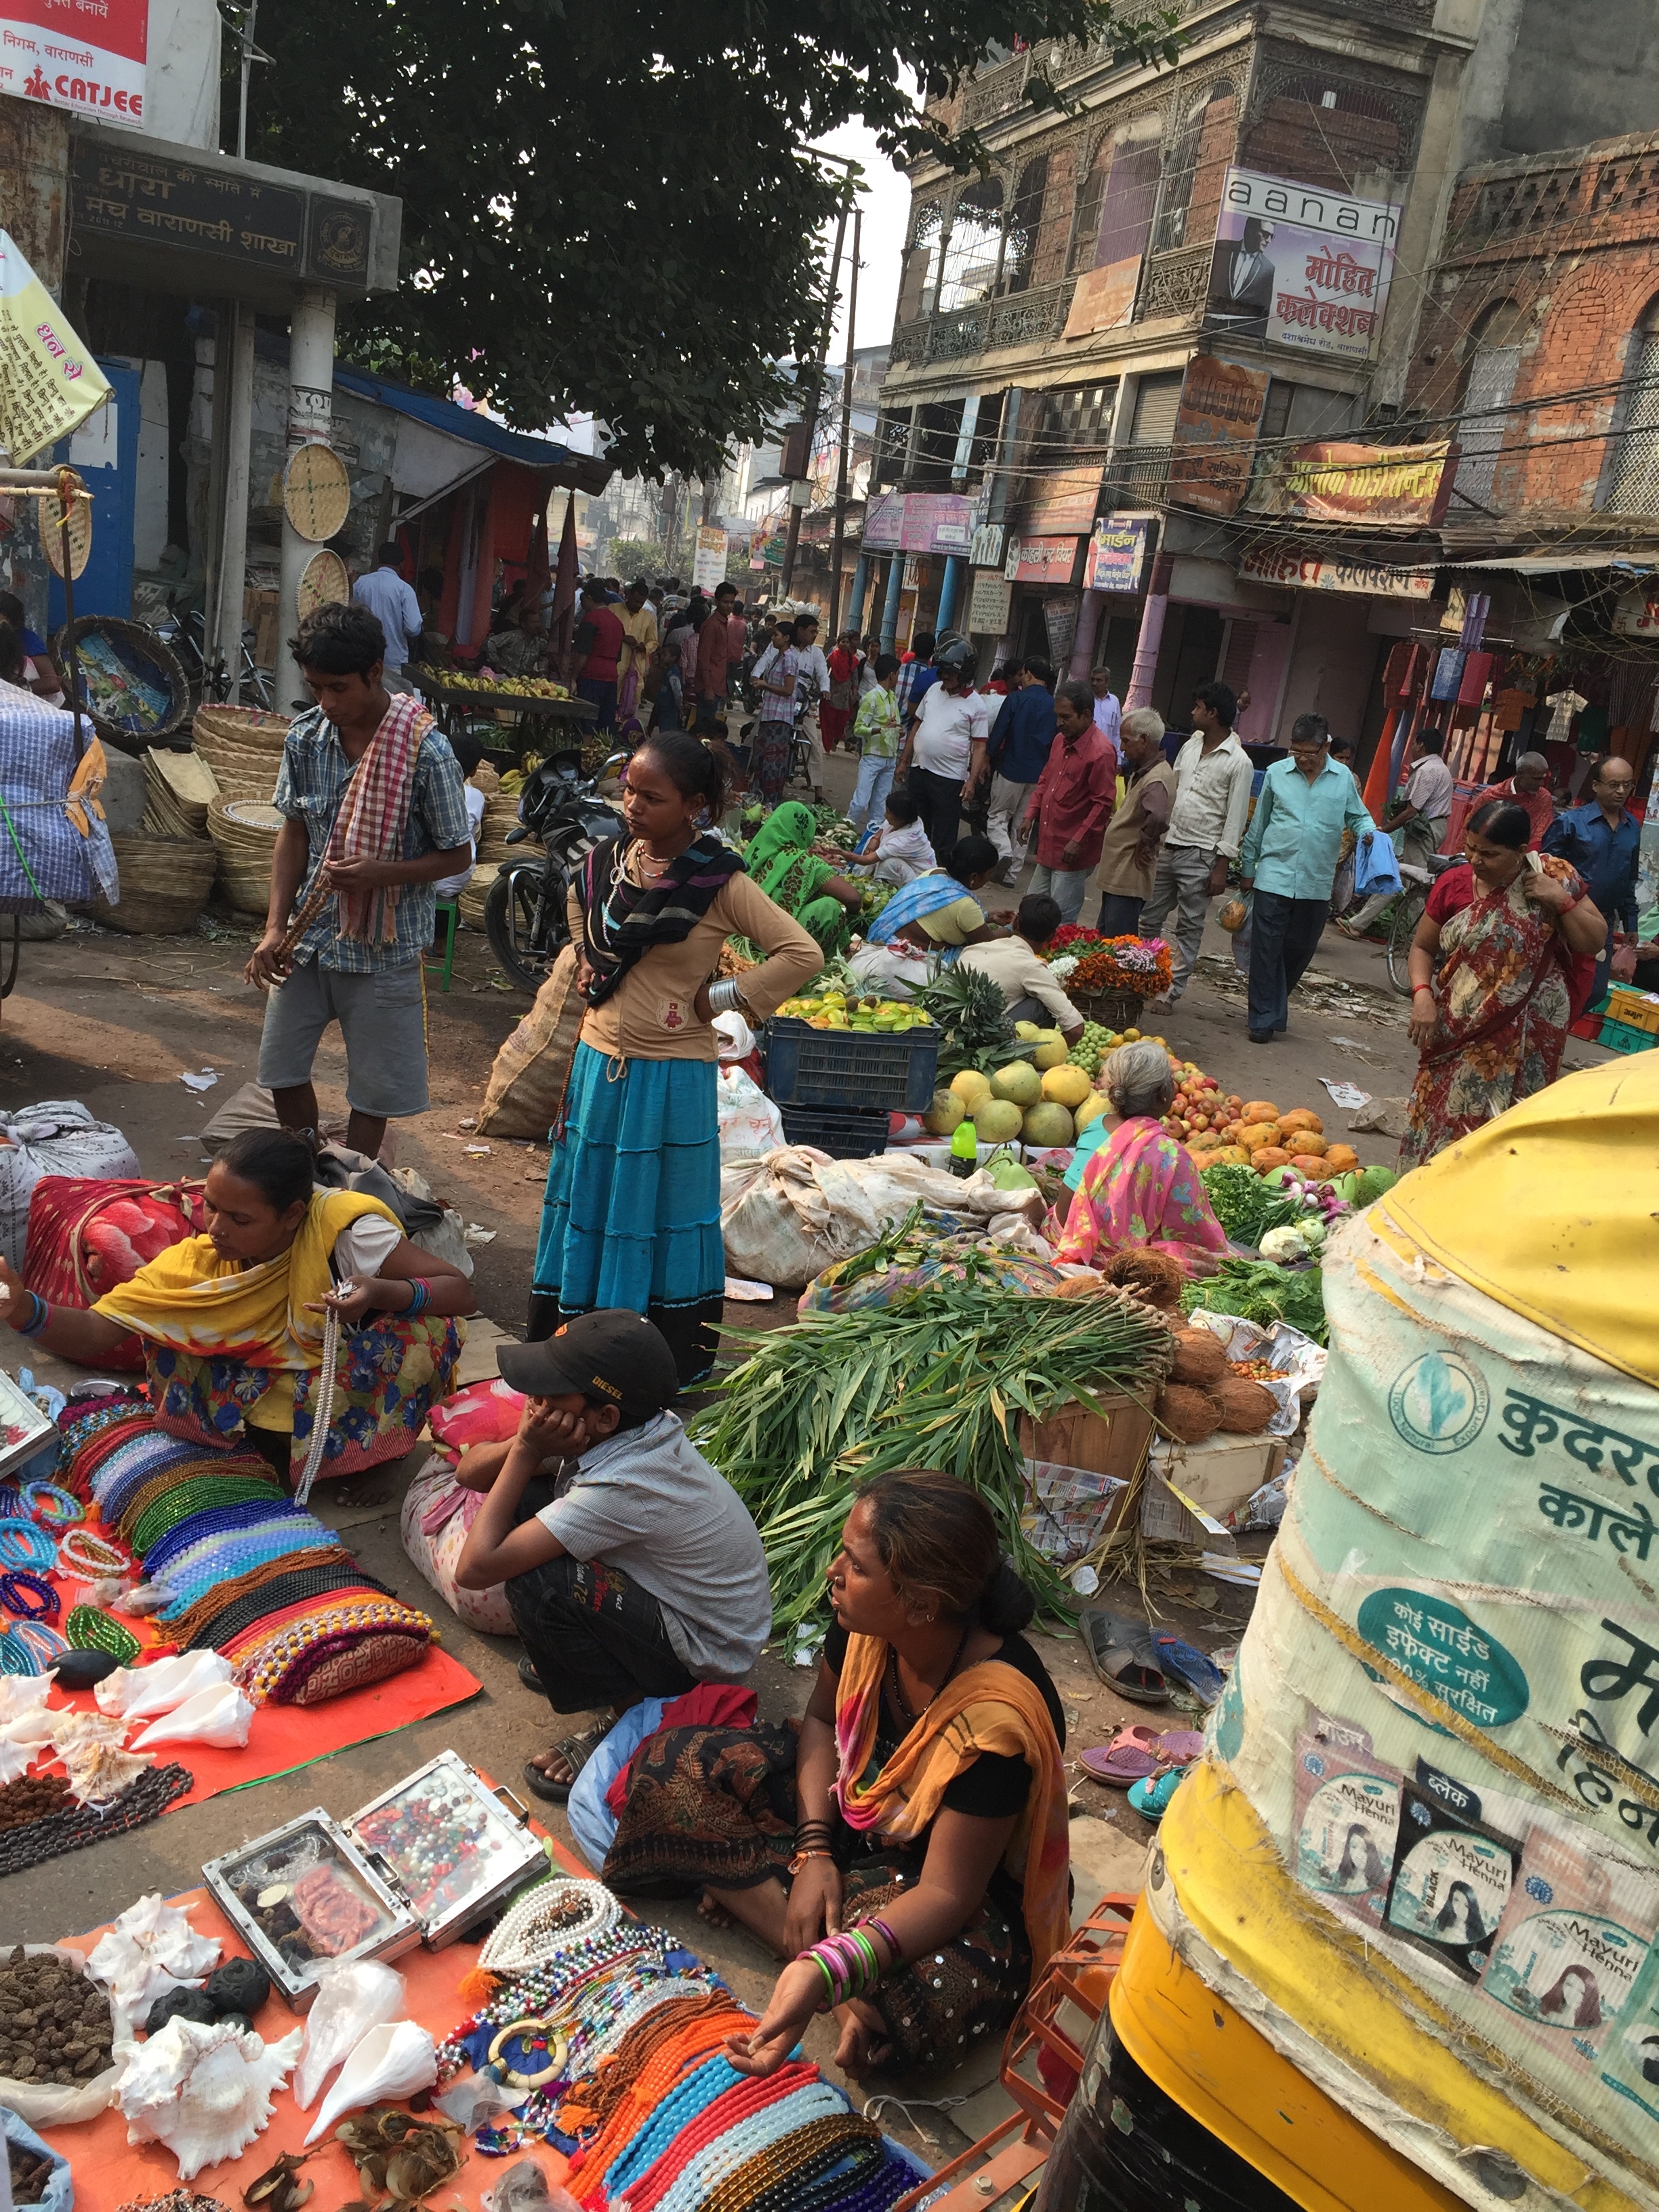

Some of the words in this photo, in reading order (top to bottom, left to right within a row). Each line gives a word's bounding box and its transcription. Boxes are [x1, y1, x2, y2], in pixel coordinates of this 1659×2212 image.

[3, 30, 40, 56] निगम,
[44, 45, 94, 68] वाराणसी
[55, 75, 142, 117] CATJEE
[71, 102, 96, 113] Education
[1229, 180, 1395, 238] aanan
[137, 207, 233, 243] वाराणसी
[240, 230, 296, 257] शाखा
[1305, 245, 1376, 298] मोहित
[1276, 285, 1379, 340] कलेक्शन
[37, 323, 66, 359] धन
[64, 361, 83, 382] से
[1286, 449, 1347, 496] आलोक
[1624, 1008, 1643, 1020] अमूल
[592, 1376, 623, 1400] DIESEL
[1452, 1415, 1483, 1446] Export
[1393, 1601, 1423, 1629] कोई
[1427, 1614, 1490, 1660] साईड
[1386, 1623, 1451, 1674] इफेक्ट
[1455, 1662, 1490, 1693] नहीं
[1433, 1681, 1498, 1723] सुरक्षित
[1338, 1783, 1396, 1816] Mayuri
[1429, 1774, 1470, 1808] ब्लैक
[1355, 1803, 1395, 1828] Henna
[1444, 1838, 1507, 1881] Mayuri
[1461, 1860, 1505, 1892] Henna
[1425, 1870, 1439, 1908] BLACK
[1565, 1921, 1639, 1971] Mayuri
[1582, 1943, 1633, 1983] Henna
